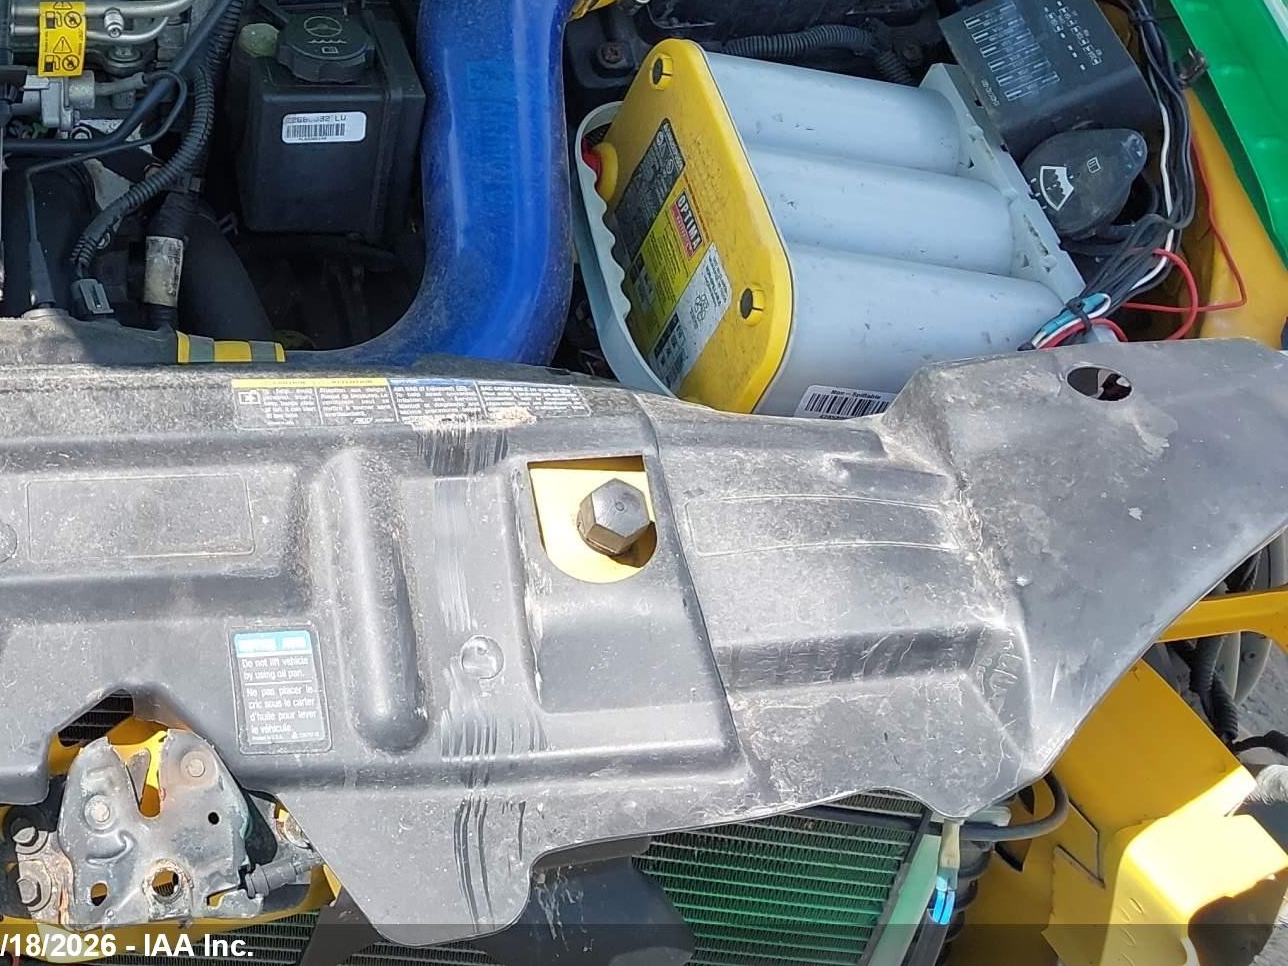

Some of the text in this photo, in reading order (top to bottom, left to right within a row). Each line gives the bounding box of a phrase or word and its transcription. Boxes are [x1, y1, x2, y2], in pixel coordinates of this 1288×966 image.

[677, 194, 703, 251] OPTIMA
[852, 391, 881, 400] Spillable
[242, 656, 309, 668] Do not lift vehicle
[244, 669, 305, 681] by using oil pan.
[247, 684, 313, 698] Ne pas placer le
[248, 698, 315, 709] cric sous le carter
[250, 709, 317, 722] d'huile pour lever
[251, 722, 294, 734] le véhicule.
